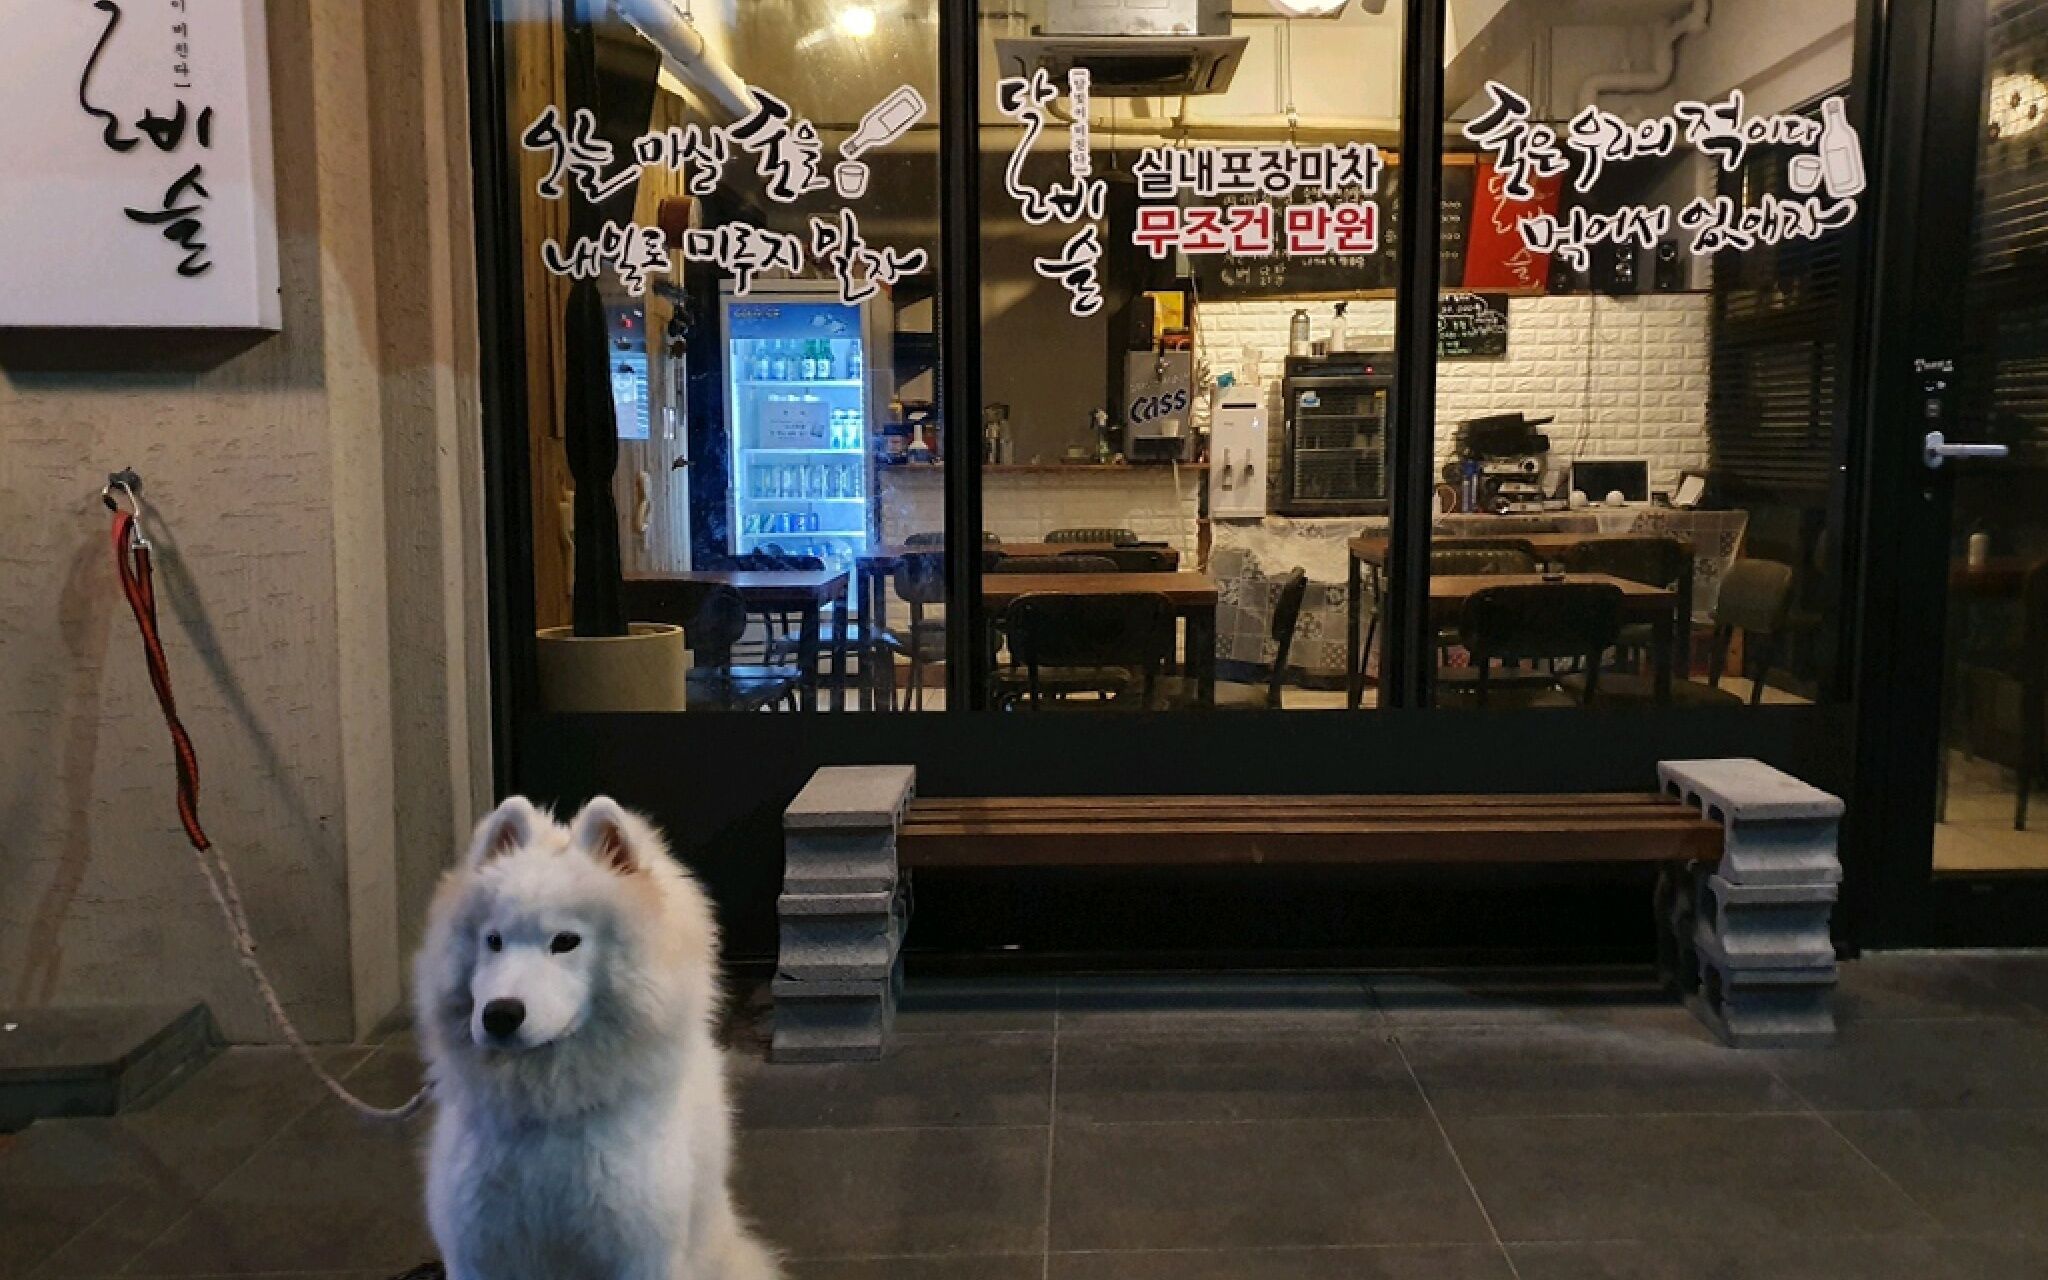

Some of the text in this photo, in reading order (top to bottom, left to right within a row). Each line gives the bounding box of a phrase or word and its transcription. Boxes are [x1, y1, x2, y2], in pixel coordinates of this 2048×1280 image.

[522, 88, 829, 199] 오늘 마실 술을
[1136, 146, 1381, 195] 실내포장마차
[1465, 82, 1820, 197] 술은 우리의 적이다
[545, 209, 925, 301] 내일로 미루지 말자
[1135, 205, 1269, 256] 무조건
[1288, 203, 1376, 252] 만원
[1521, 207, 1666, 268] 먹어서
[1680, 197, 1853, 251] 없애자
[1129, 387, 1187, 425] Cass
